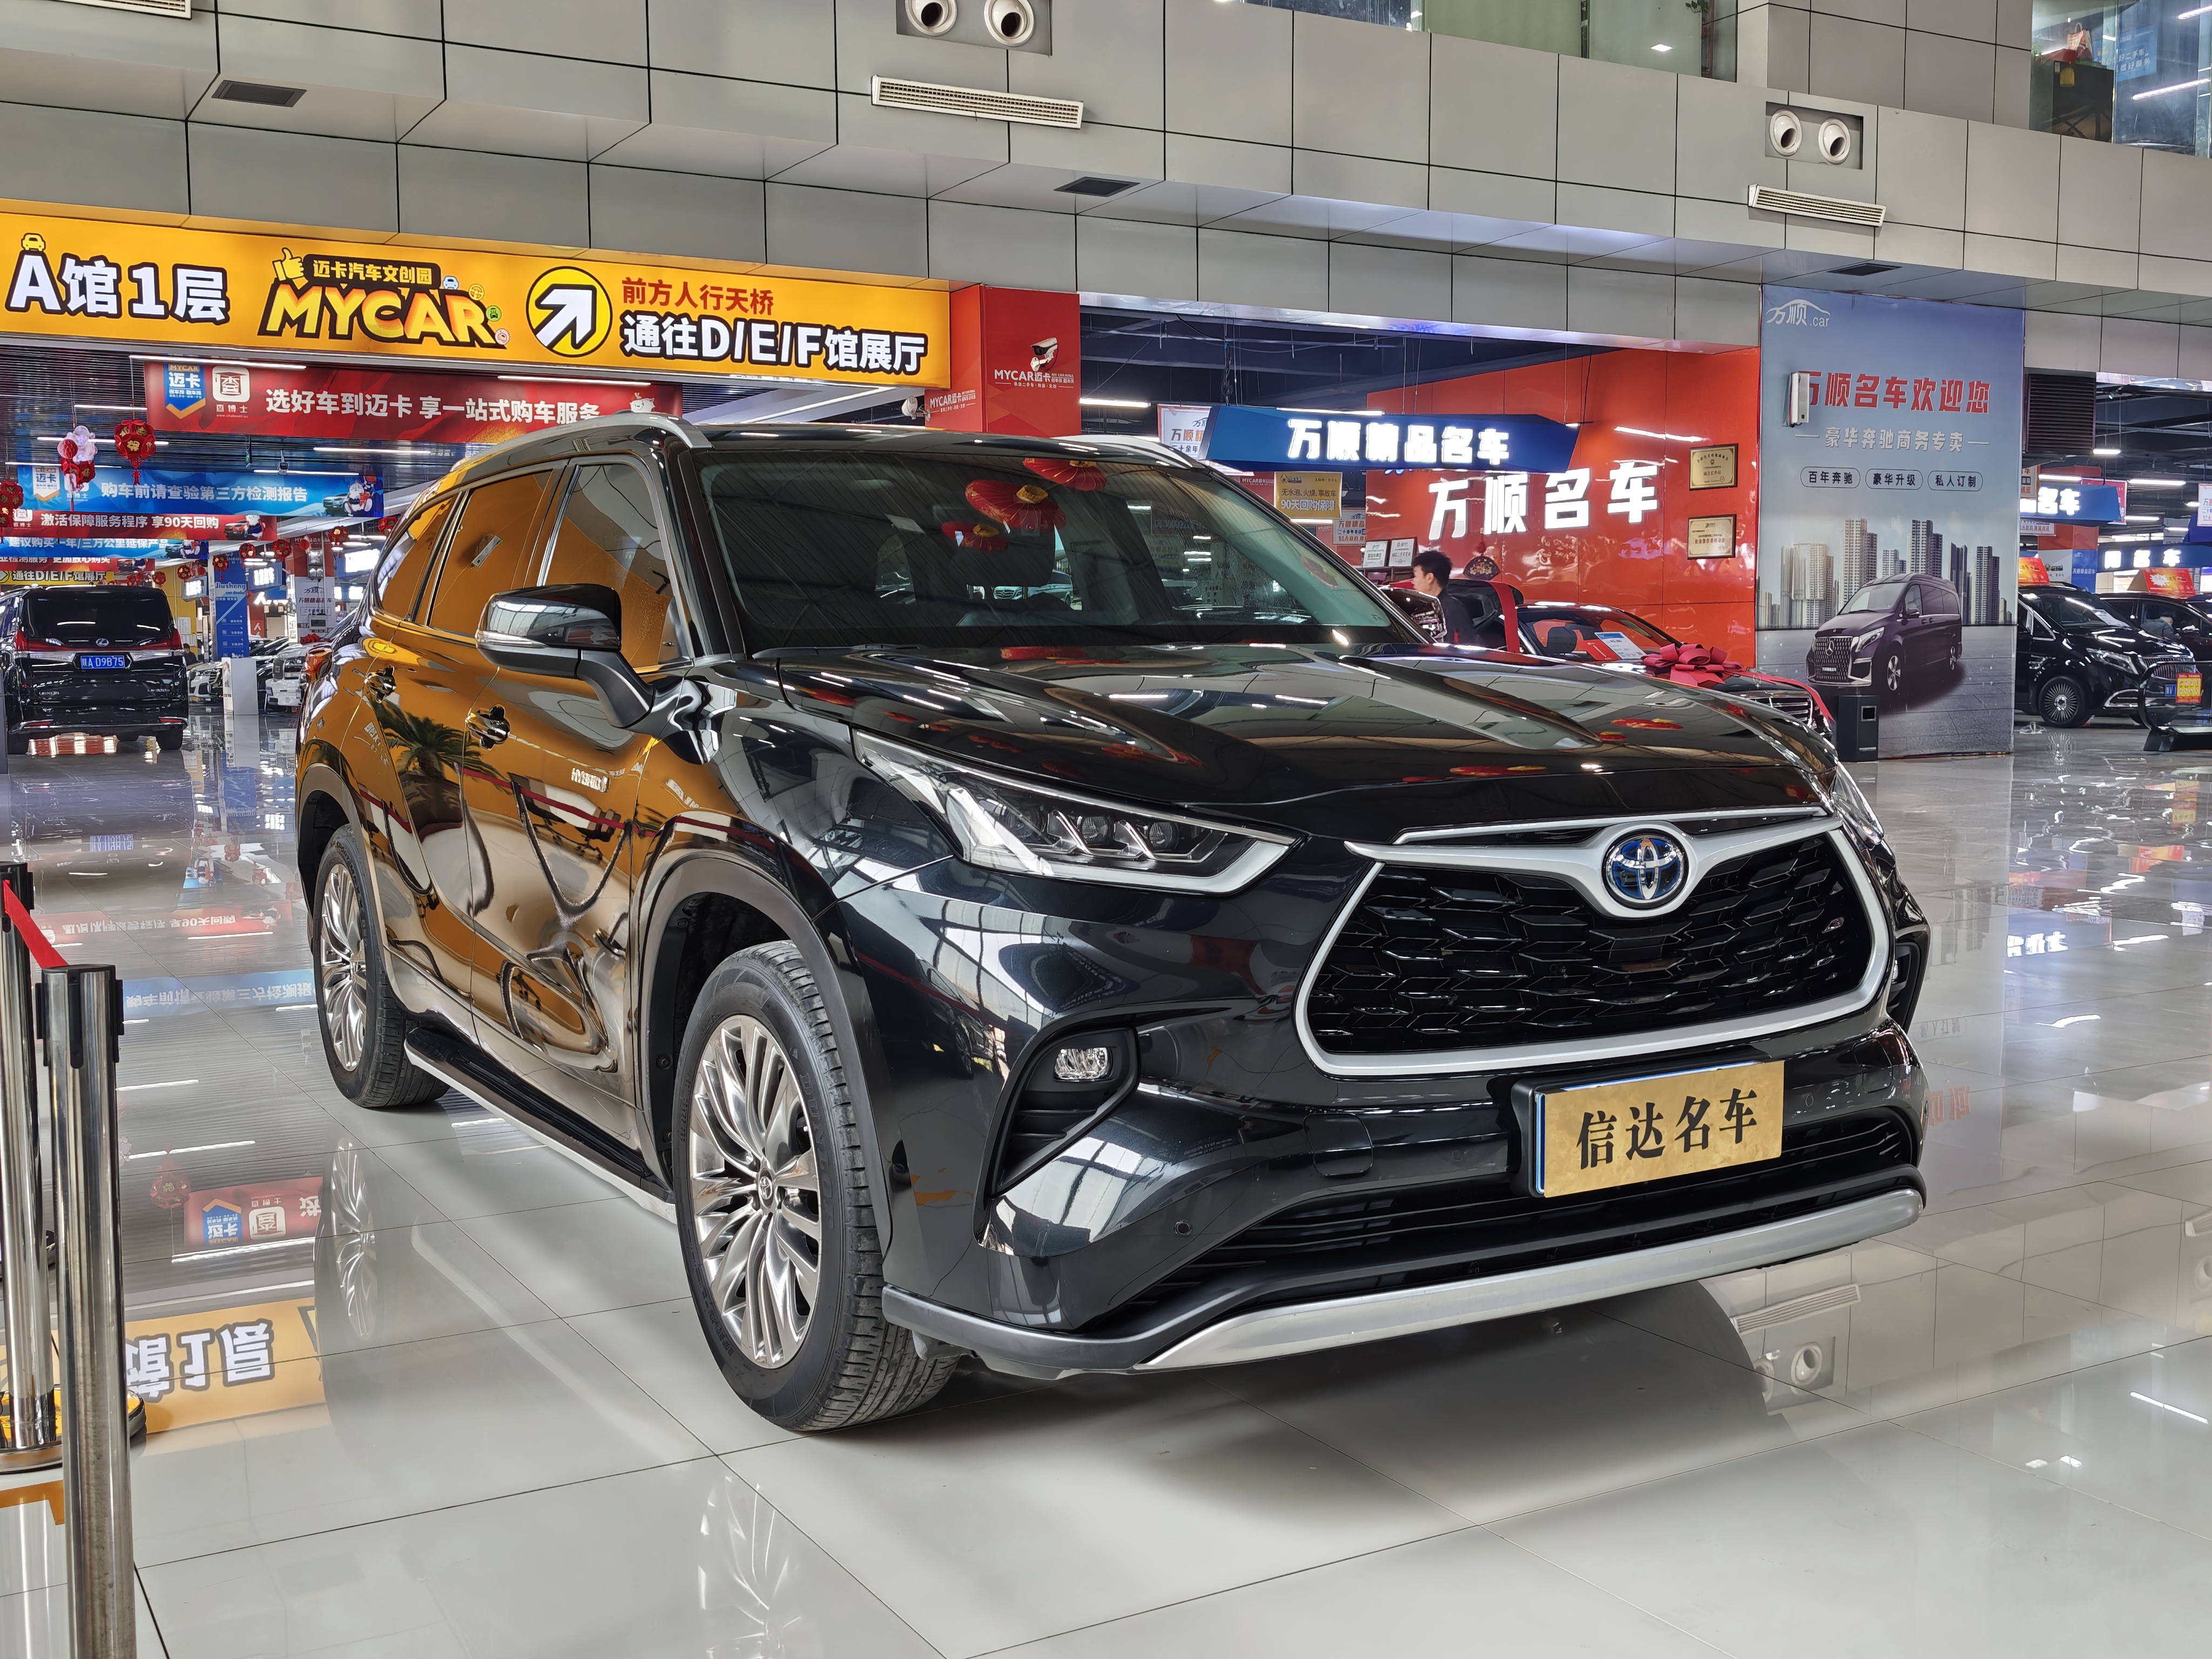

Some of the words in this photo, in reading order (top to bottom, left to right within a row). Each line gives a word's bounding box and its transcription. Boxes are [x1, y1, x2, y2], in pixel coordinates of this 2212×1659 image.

[312, 260, 433, 285] 迈卡汽车文创园
[9, 255, 227, 322] A馆1层
[622, 277, 774, 315] 前方人行天桥
[265, 283, 498, 346] MYCAR
[624, 315, 925, 373] 通往D/E/F馆展厅
[169, 372, 201, 388] 迈卡
[266, 387, 413, 419] 选好车到迈卡
[419, 396, 601, 424] 享一站式购车服务
[1825, 426, 1964, 453] 豪华奔驰商务专卖
[36, 473, 56, 483] 迈卡
[1808, 470, 1853, 485] 百年奔驰
[1872, 472, 1917, 487] 豪华升级
[1934, 474, 1977, 489] 私人订制
[101, 482, 308, 503] 购车前请查验第三方检测报告
[1427, 461, 1660, 541] 万顺名车
[1280, 499, 1336, 511] 90天回购保障
[41, 513, 148, 528] 激活保障服务程序
[151, 515, 219, 529] 享90天回购
[215, 582, 246, 590] Jiusheng
[1575, 1087, 1758, 1170] 信达名车
